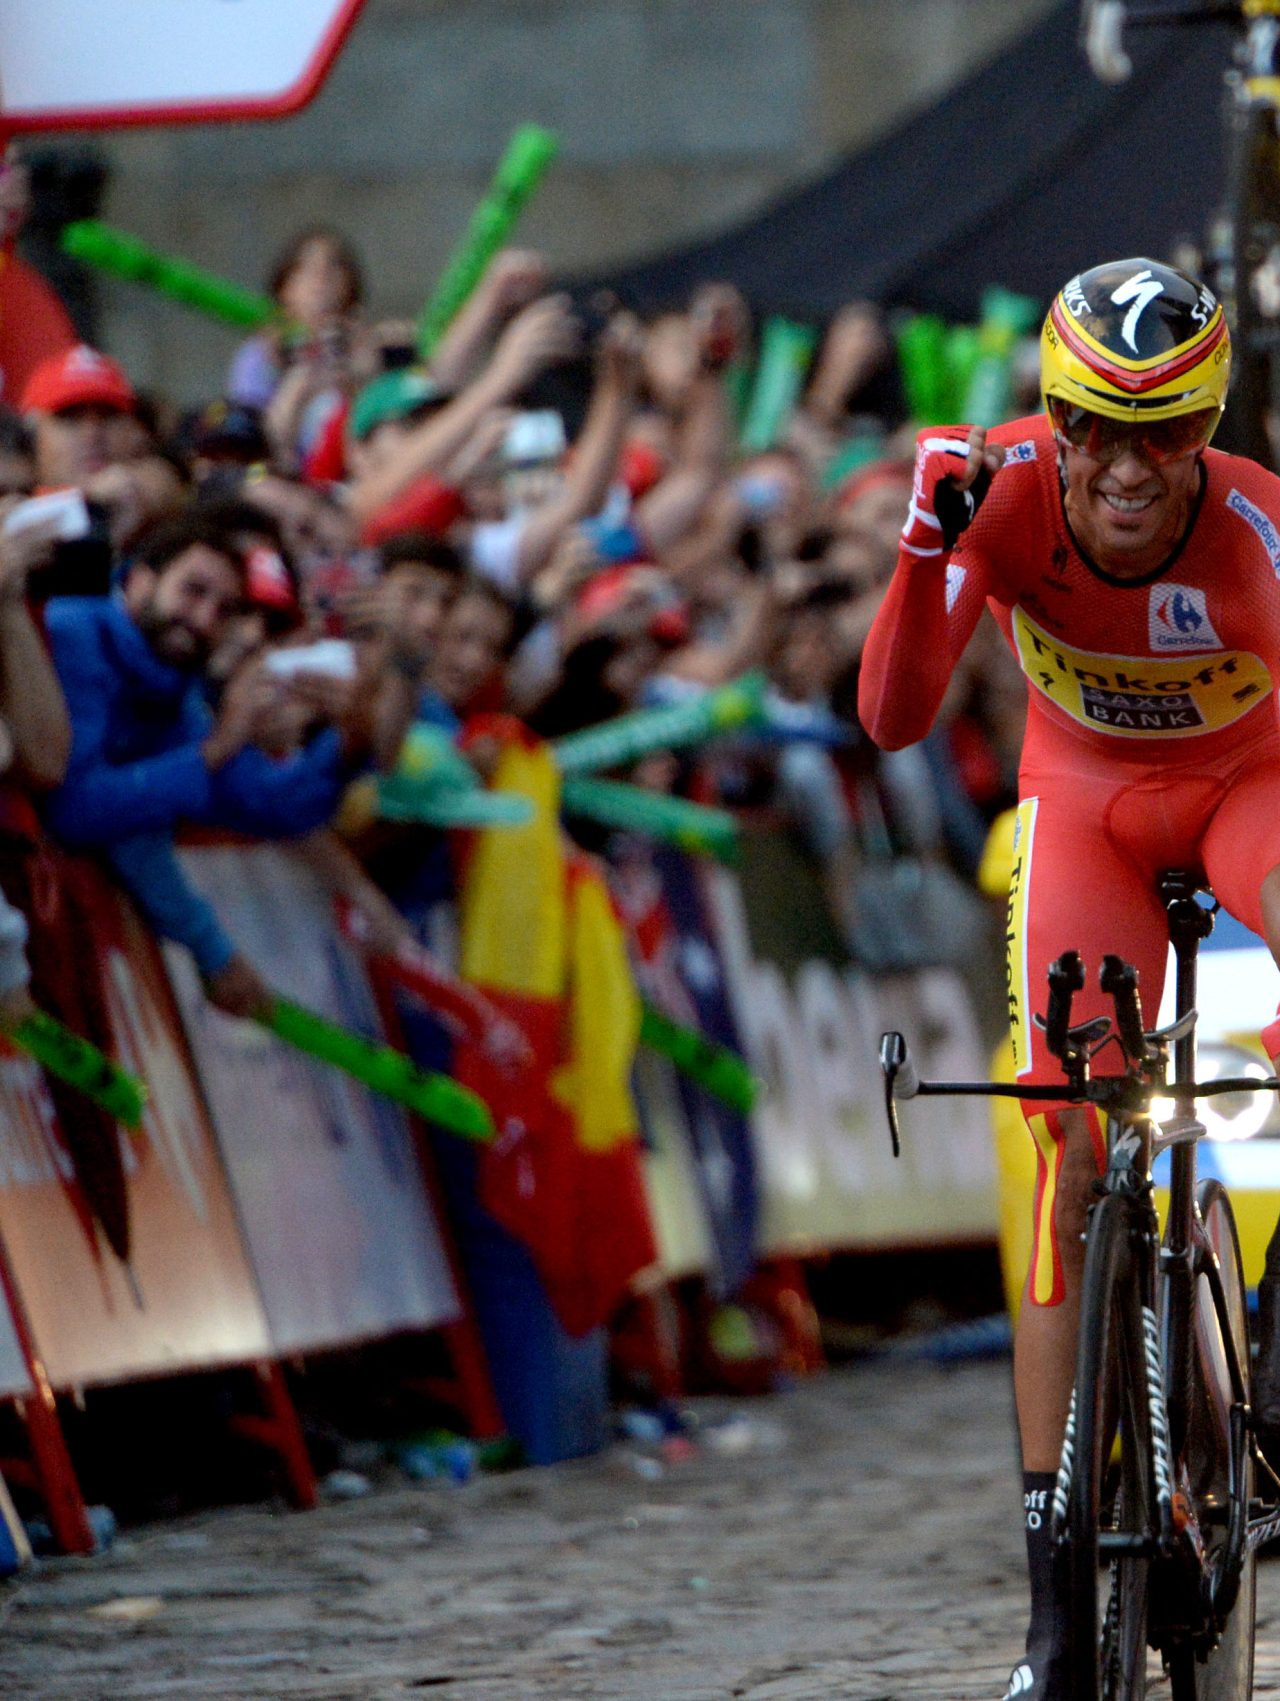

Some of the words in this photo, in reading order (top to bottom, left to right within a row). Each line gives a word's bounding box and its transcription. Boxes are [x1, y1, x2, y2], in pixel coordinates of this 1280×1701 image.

[1231, 495, 1277, 551] Carrefour
[1024, 623, 1238, 692] Tinkoff
[1085, 688, 1183, 708] SAXO
[1094, 706, 1190, 727] BANK
